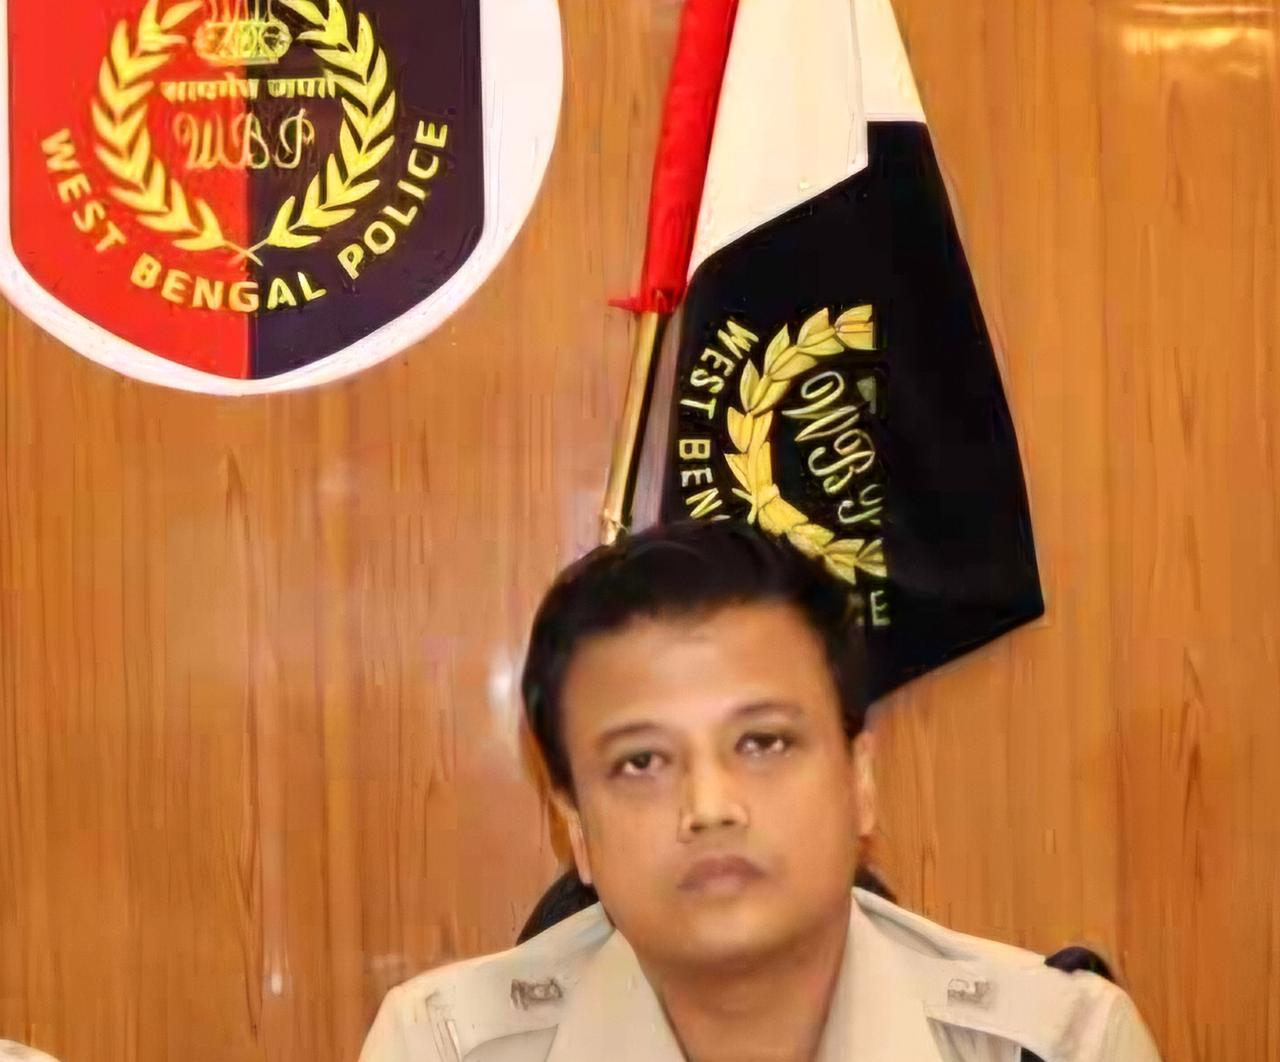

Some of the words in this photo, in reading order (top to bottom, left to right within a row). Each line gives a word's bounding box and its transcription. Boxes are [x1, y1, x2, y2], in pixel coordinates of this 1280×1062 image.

[39, 127, 126, 254] WEST
[129, 252, 328, 313] BENGAL
[336, 119, 449, 280] POLICE
[680, 319, 758, 419] WEST
[678, 438, 729, 521] BEN
